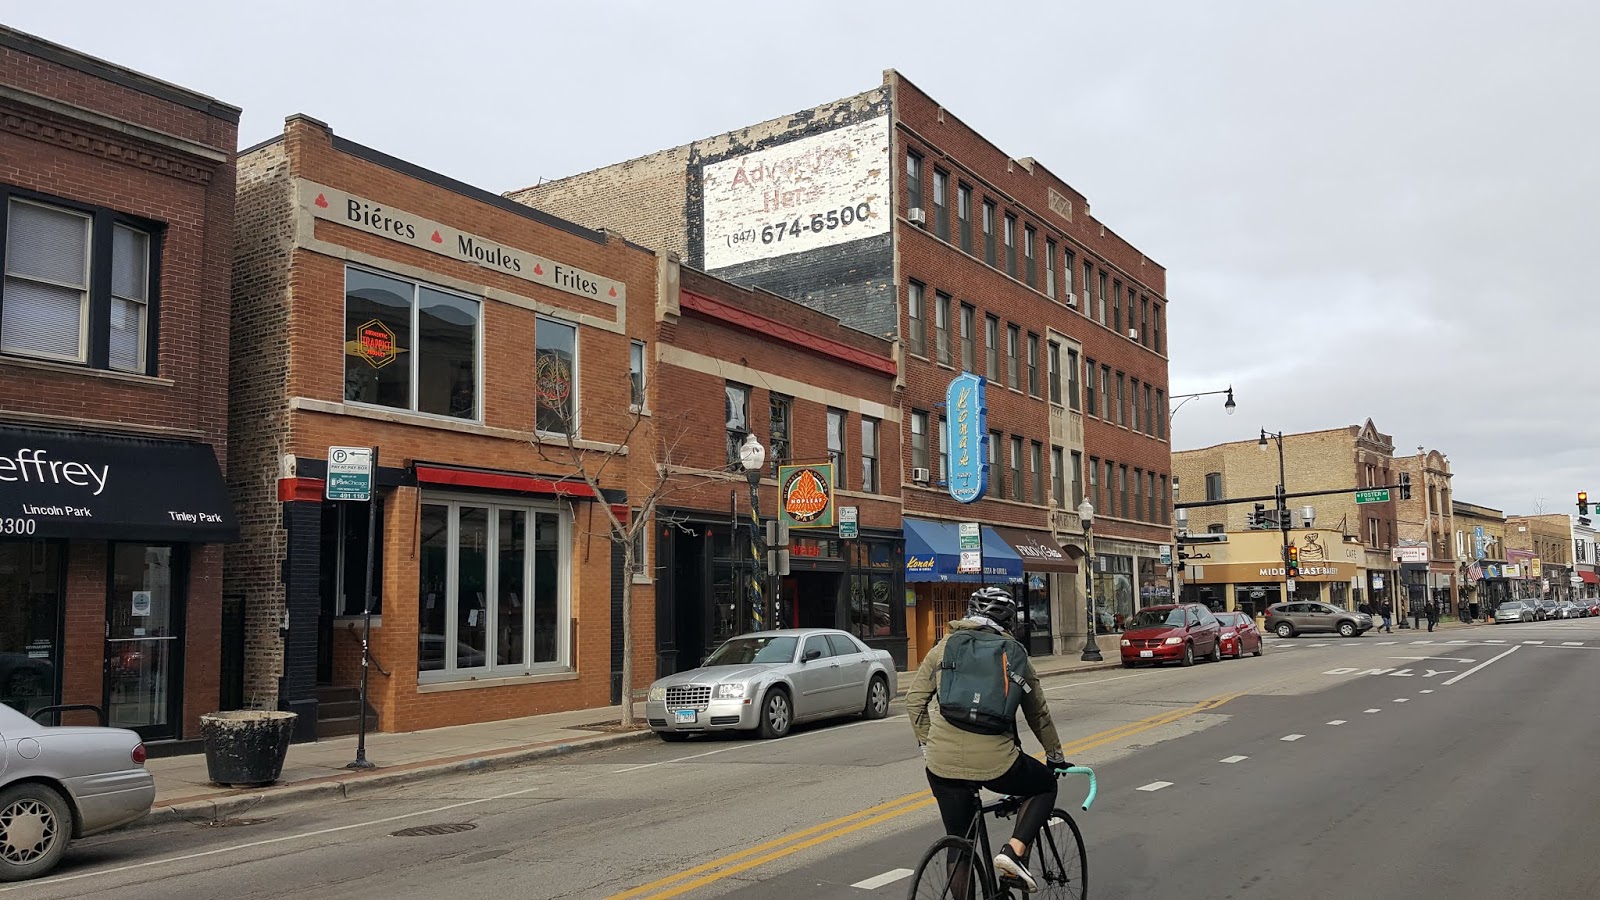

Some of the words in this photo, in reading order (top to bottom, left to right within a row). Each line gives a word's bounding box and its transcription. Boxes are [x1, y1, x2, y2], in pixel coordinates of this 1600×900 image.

[727, 230, 756, 247] (847)
[761, 203, 870, 244] 674-6500
[347, 199, 416, 240] Biéres
[458, 234, 521, 272] Moules
[554, 265, 598, 295] Frites
[0, 449, 109, 496] effrey
[23, 504, 64, 516] Lincoln
[65, 506, 92, 517] Park
[168, 511, 197, 523] Tinley
[199, 513, 223, 523] Park
[906, 556, 935, 568] Konak
[1259, 568, 1286, 576] MIDD
[1298, 567, 1321, 575] EAST
[1321, 667, 1457, 678] ONLY
